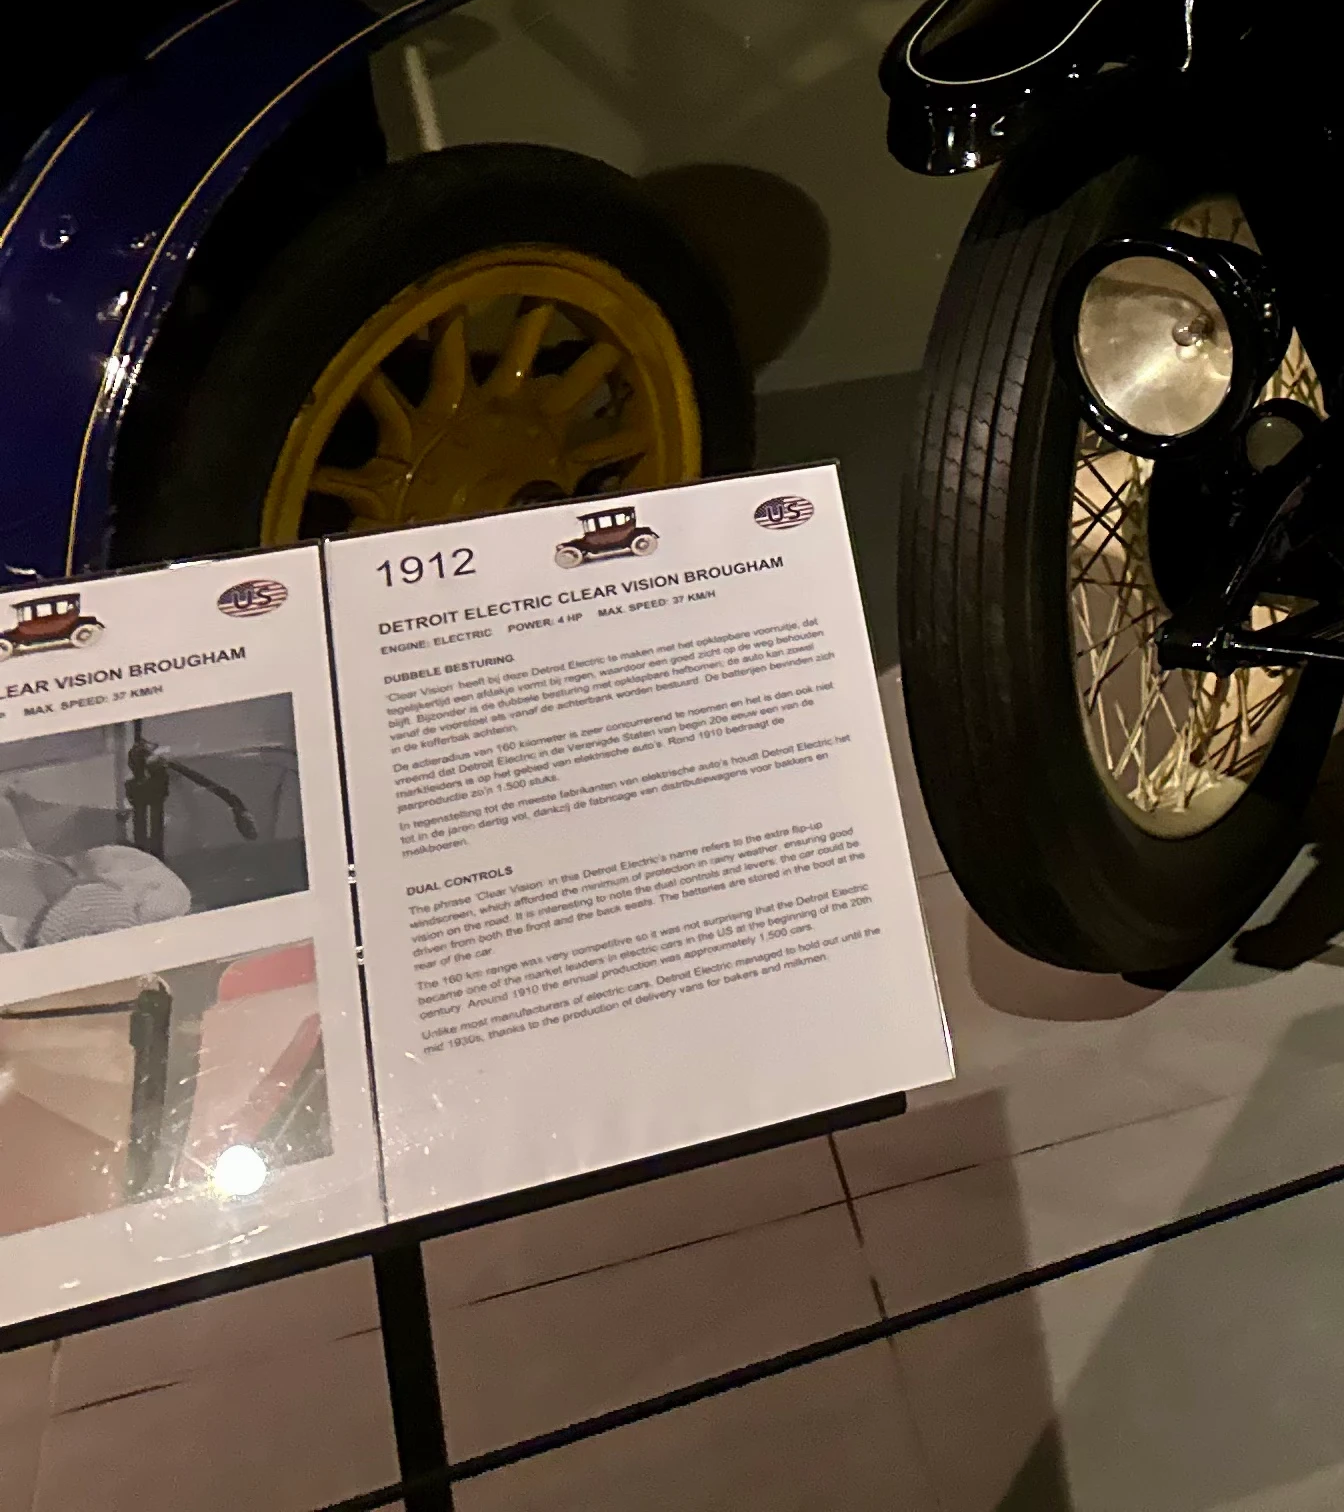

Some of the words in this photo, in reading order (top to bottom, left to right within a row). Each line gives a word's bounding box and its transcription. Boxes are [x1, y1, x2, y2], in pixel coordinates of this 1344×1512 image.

[768, 500, 801, 522] US
[376, 548, 476, 587] 1912
[379, 610, 457, 634] DETROIT
[464, 594, 553, 620] ELECTRIC
[558, 584, 618, 604] CLEAR
[622, 573, 680, 593] VISION
[684, 556, 785, 583] BROUGHAM
[54, 667, 122, 690] VISION
[128, 646, 246, 677] BROUGHAM
[384, 666, 441, 684] DUBBELE
[444, 653, 514, 674] BESTURING
[406, 880, 440, 896] DUAL
[444, 865, 513, 888] CONTROLS
